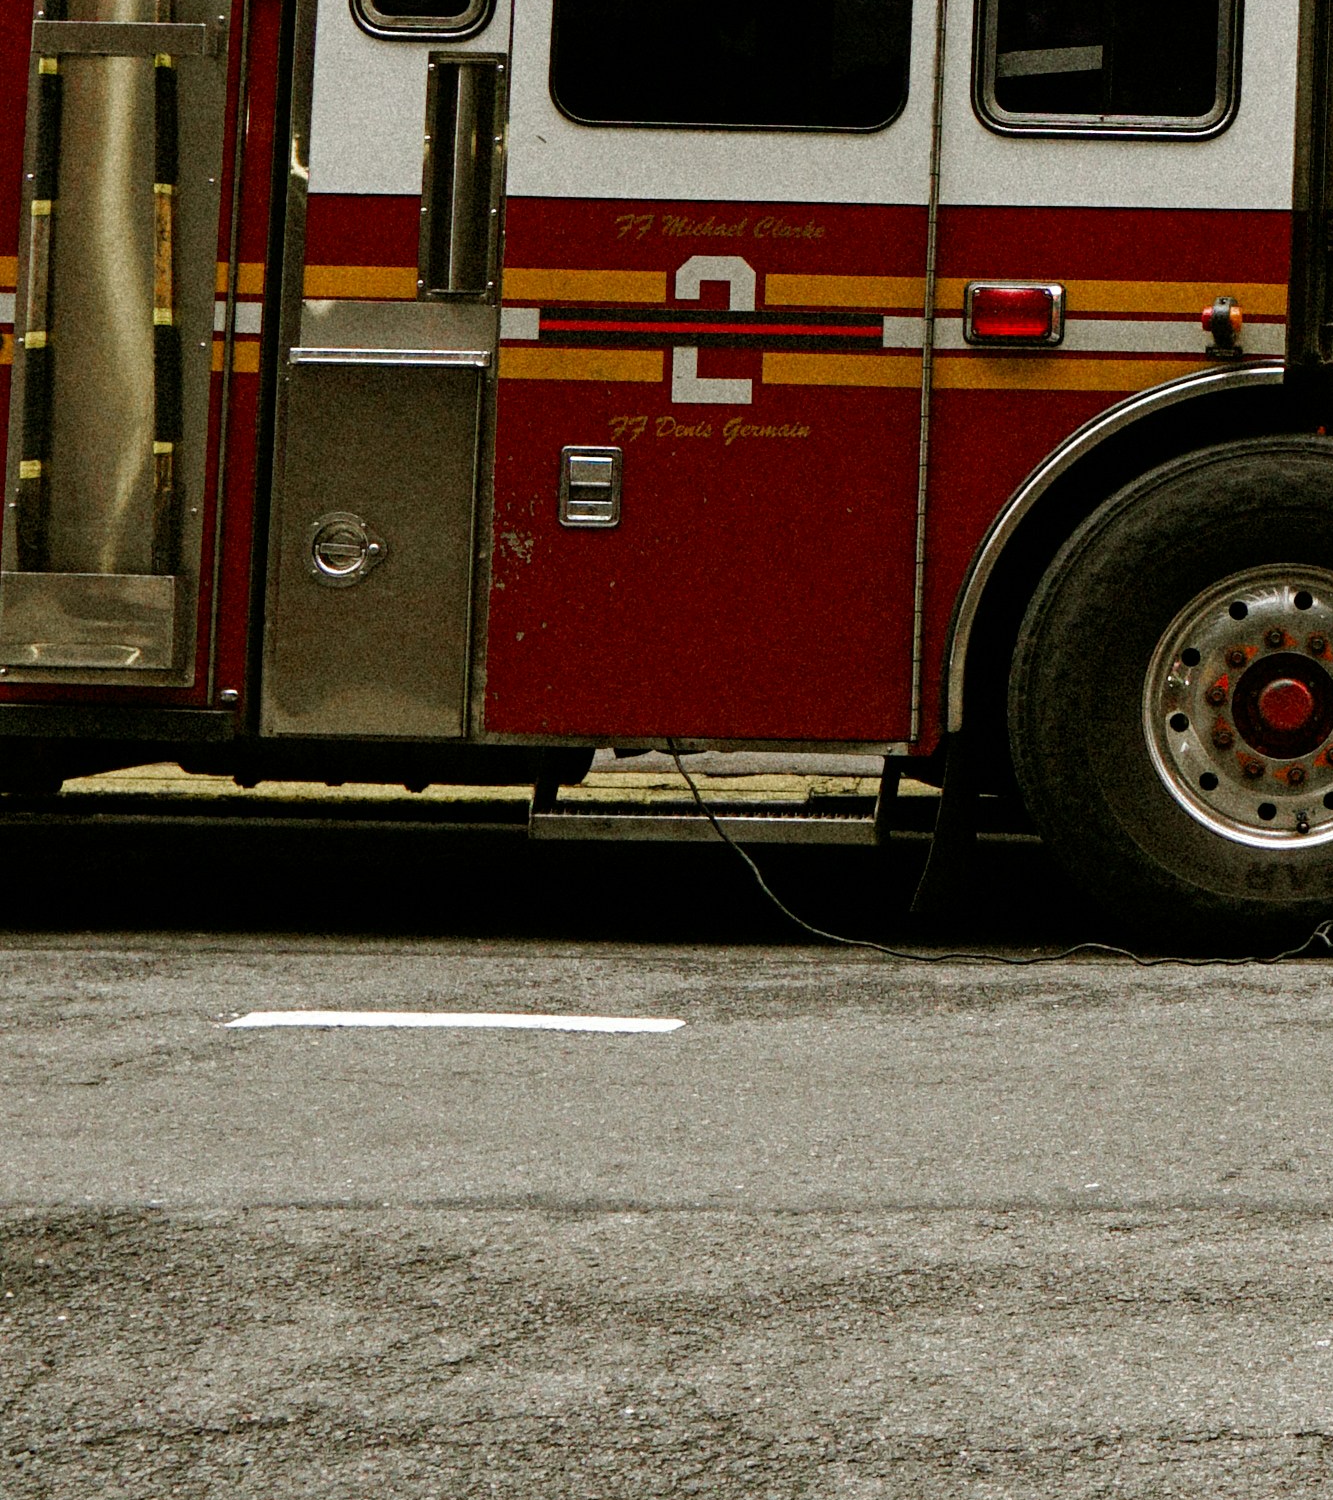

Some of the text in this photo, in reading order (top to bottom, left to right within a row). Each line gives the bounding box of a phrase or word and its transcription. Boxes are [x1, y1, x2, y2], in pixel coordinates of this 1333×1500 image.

[661, 214, 749, 238] Michael
[753, 215, 826, 239] Clarke
[655, 415, 715, 439] Denis
[721, 416, 812, 446] Germain
